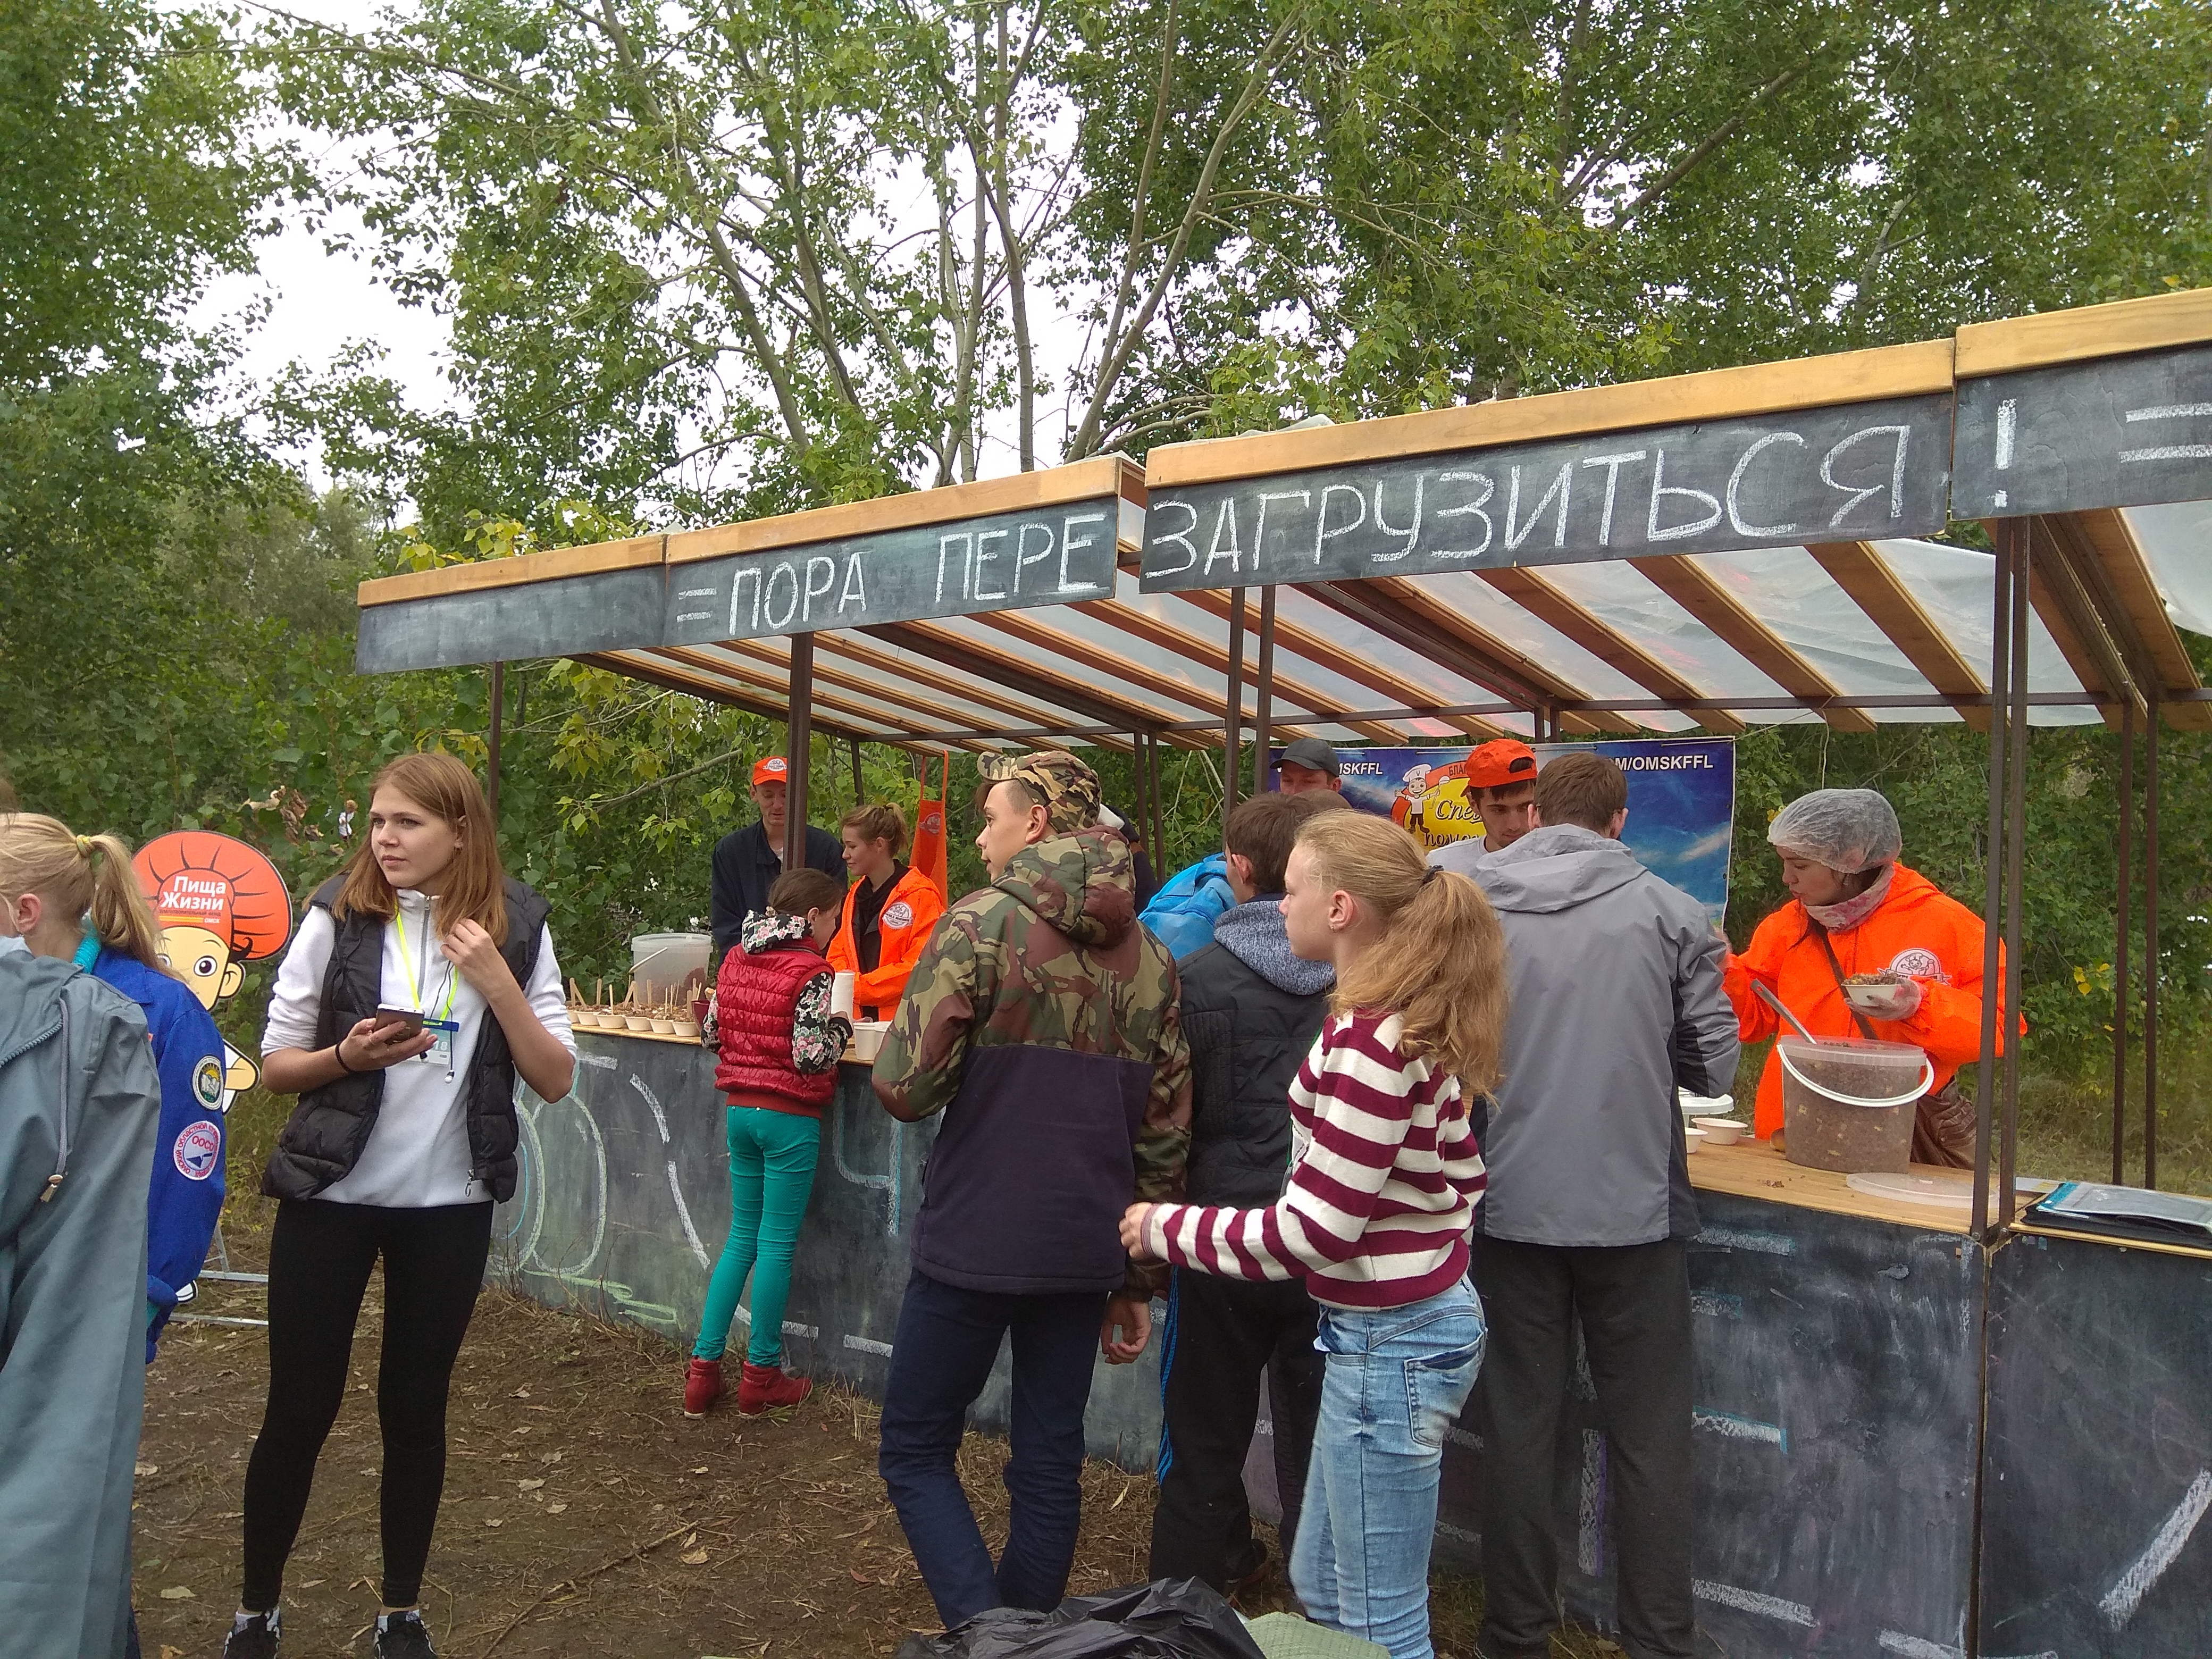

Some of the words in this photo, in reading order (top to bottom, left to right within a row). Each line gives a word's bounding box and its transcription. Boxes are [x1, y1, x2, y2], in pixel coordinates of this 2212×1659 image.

[728, 551, 868, 636] ПОРА
[935, 513, 1111, 602] ПЕРЕ
[1145, 425, 1911, 579] ЗАГРУЗИТЬСЯ
[174, 876, 227, 897] Пища
[161, 892, 224, 910] Жизни
